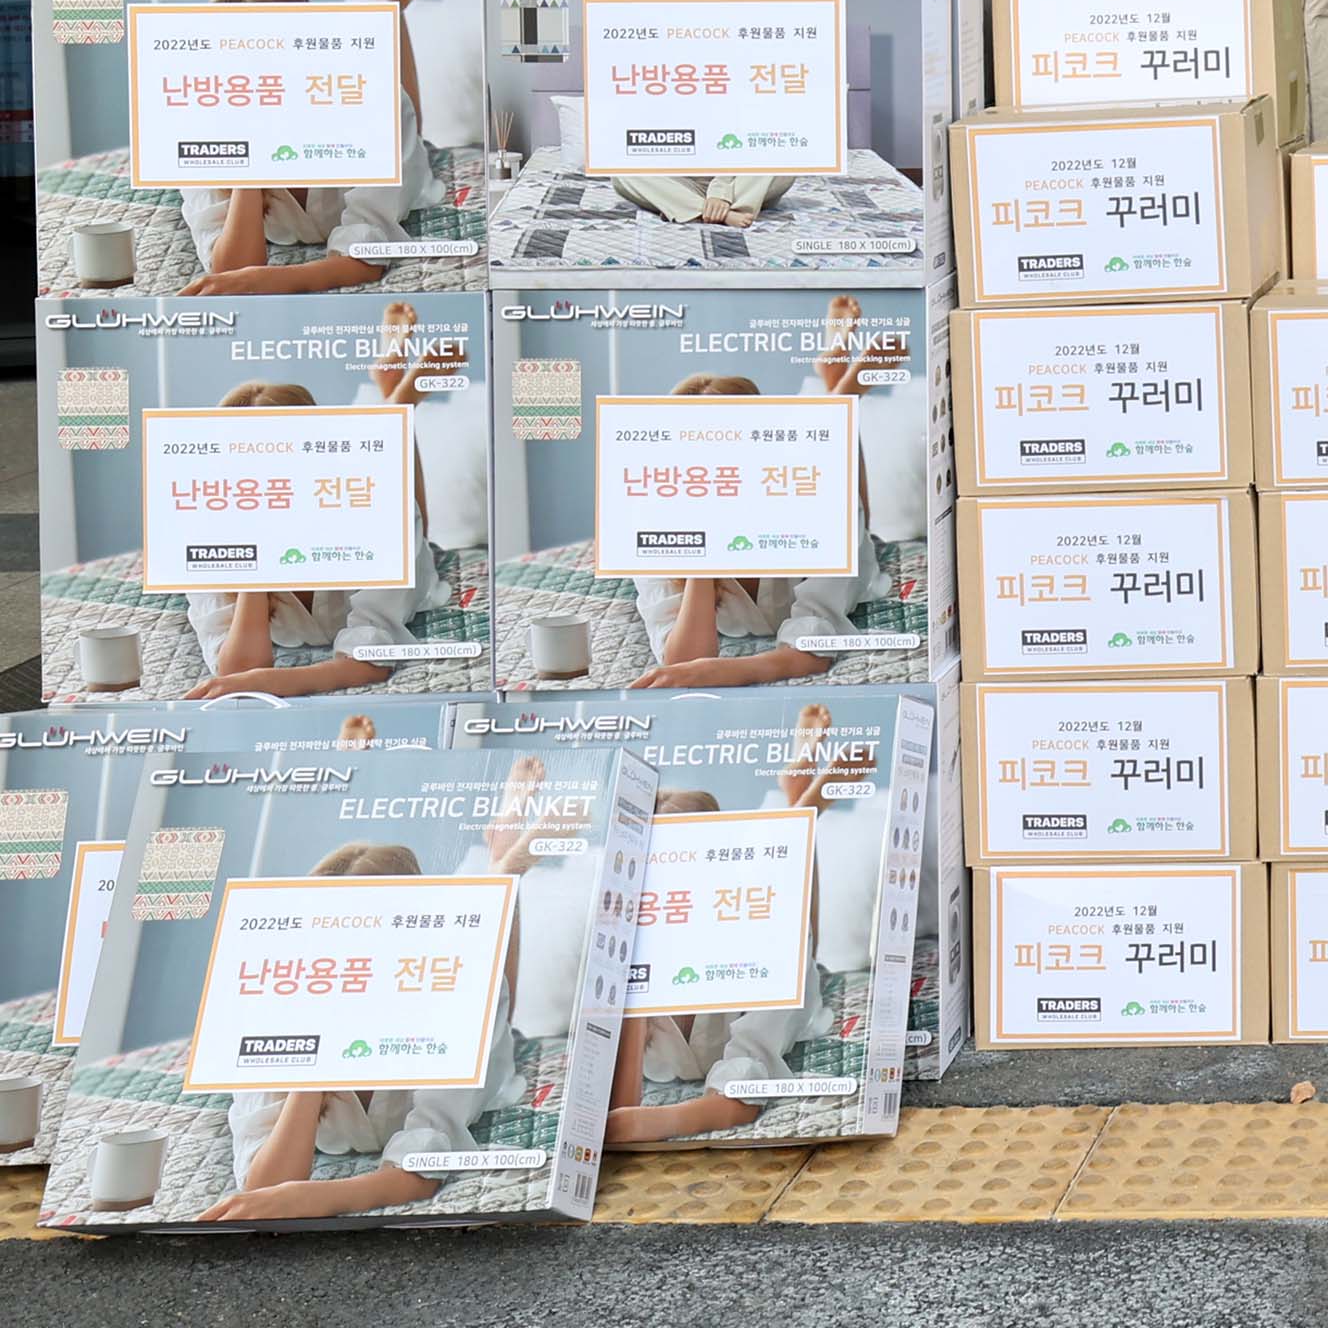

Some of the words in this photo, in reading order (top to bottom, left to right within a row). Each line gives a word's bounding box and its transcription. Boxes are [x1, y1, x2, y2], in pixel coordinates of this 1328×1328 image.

[154, 39, 211, 51] 2022년도
[220, 38, 285, 50] PEACOCK
[293, 38, 342, 50] 후원물품
[351, 37, 374, 49] 지원
[1032, 50, 1122, 83] 피코크
[1141, 47, 1230, 80] 꾸러미
[163, 75, 285, 107] 난방용품
[305, 74, 367, 105] 전달
[612, 64, 731, 95] 난방용품
[749, 64, 809, 94] 전달
[180, 143, 247, 156] TRADERS
[352, 244, 393, 257] SINGLE
[397, 243, 419, 256] 180
[430, 242, 476, 257] 100(cm)
[624, 466, 742, 497] 난방용품
[761, 465, 821, 496] 전달
[149, 763, 354, 787] GLÜHWEIN
[338, 797, 466, 821] ELECTRIC
[471, 794, 596, 819] BLANKET
[534, 840, 584, 854] GK-322
[239, 958, 373, 995] 난방용품
[394, 956, 463, 992] 전달
[243, 1036, 318, 1055] TRADERS
